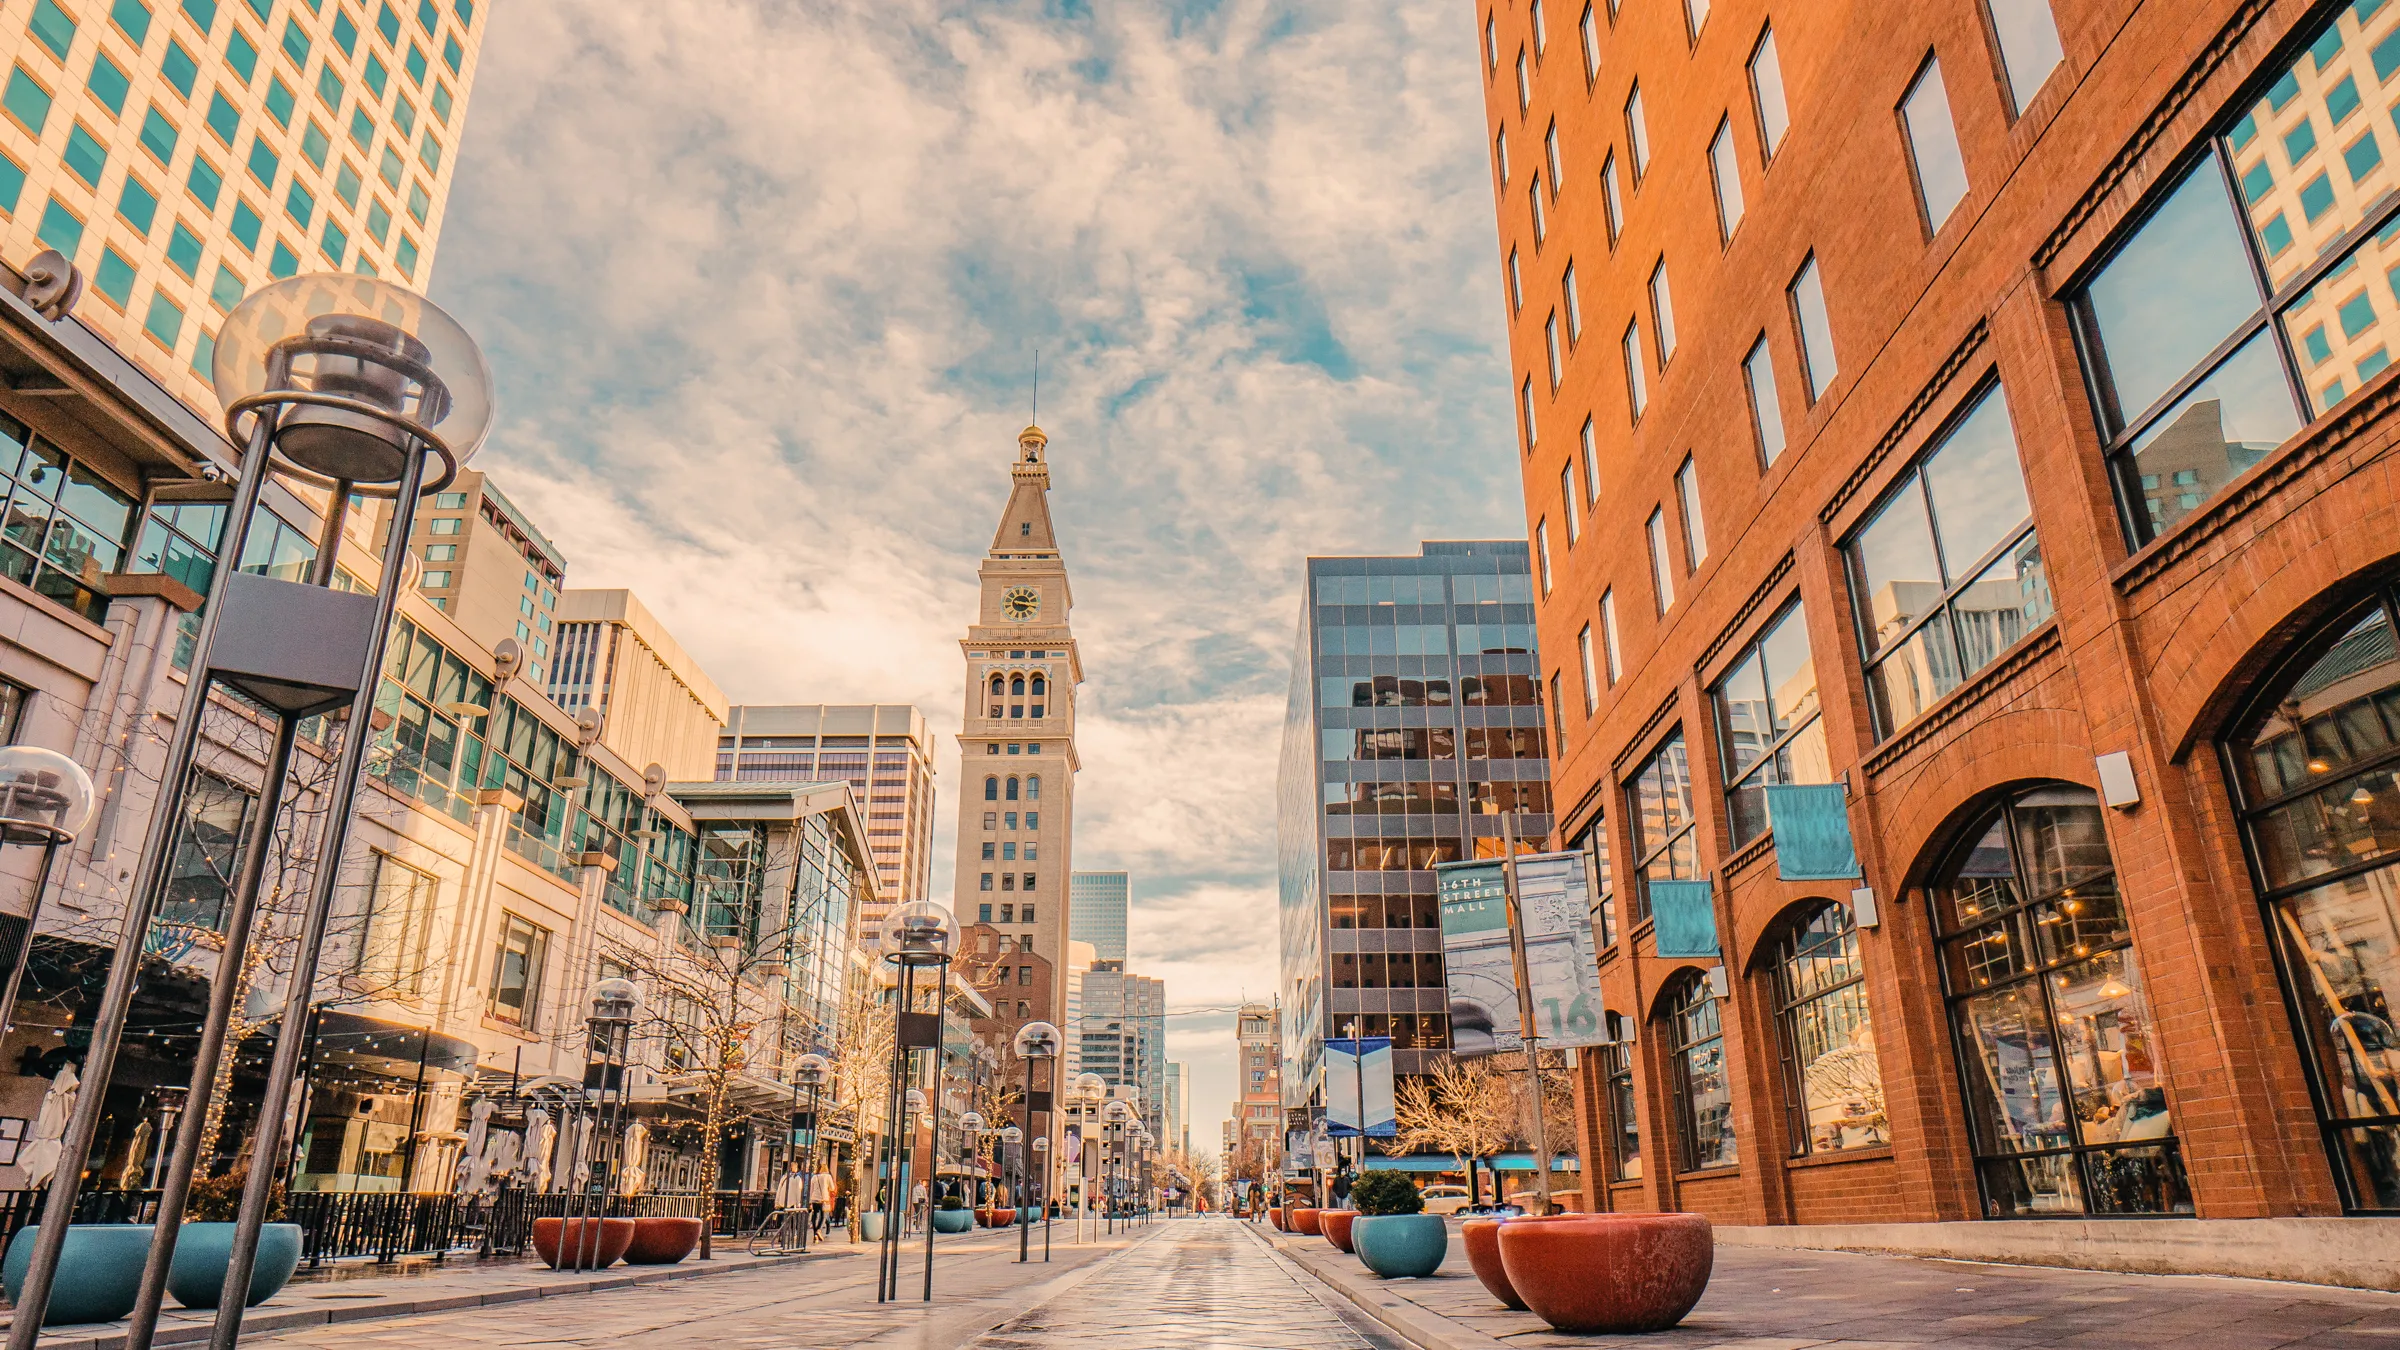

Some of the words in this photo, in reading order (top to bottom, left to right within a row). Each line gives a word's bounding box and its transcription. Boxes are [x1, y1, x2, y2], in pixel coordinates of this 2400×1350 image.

[1442, 878, 1481, 890] 16TH
[1443, 888, 1501, 902] STREET
[1444, 902, 1485, 914] MALL
[1541, 993, 1596, 1039] 16
[1317, 1151, 1332, 1165] 16
